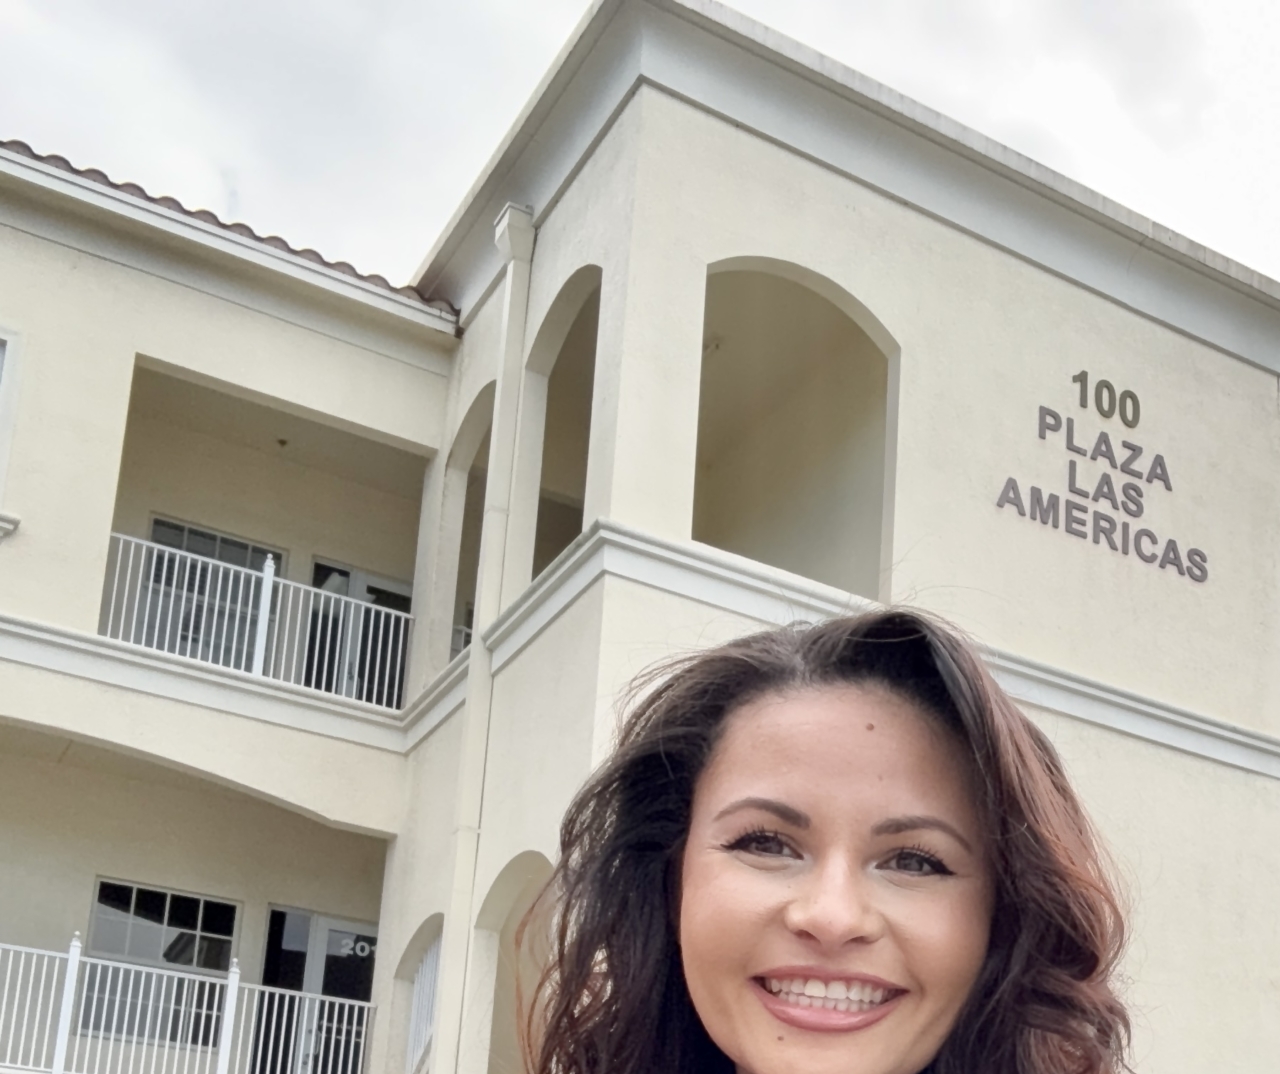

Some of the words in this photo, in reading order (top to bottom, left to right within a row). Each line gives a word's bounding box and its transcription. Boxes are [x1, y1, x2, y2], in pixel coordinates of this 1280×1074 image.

[1071, 369, 1141, 429] 100
[1037, 404, 1173, 492] PLAZA
[1067, 459, 1144, 518] LAS
[996, 476, 1209, 583] AMERICAS
